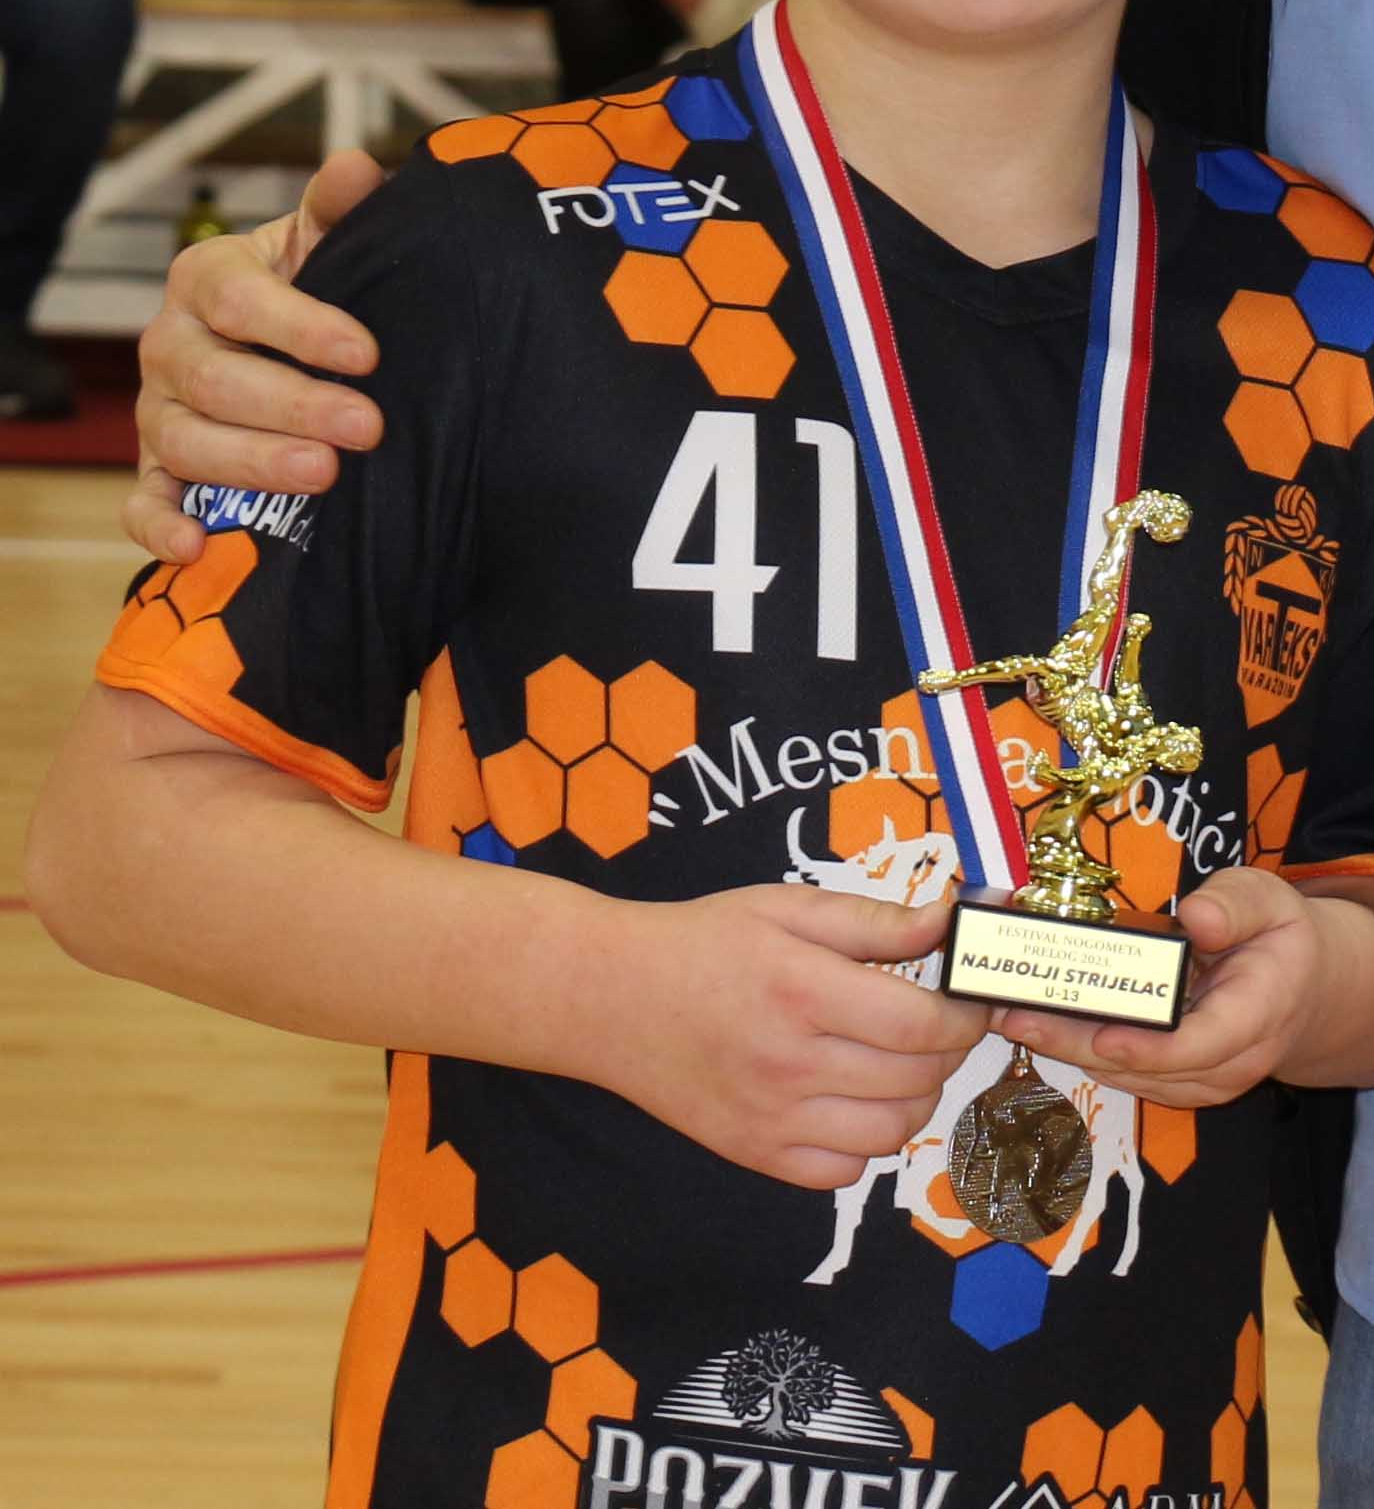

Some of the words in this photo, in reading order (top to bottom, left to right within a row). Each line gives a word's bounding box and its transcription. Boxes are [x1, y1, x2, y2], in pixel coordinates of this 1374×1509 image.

[537, 174, 741, 234] FOTEX
[632, 410, 857, 661] 41
[998, 924, 1058, 944] FESTIVAL
[1063, 935, 1143, 957] NOGOMETA
[1023, 944, 1077, 962] PRELOG
[960, 952, 1060, 981] NAJBOLJI
[1064, 968, 1169, 998] STRIJELAC
[1045, 986, 1080, 1003] U-13
